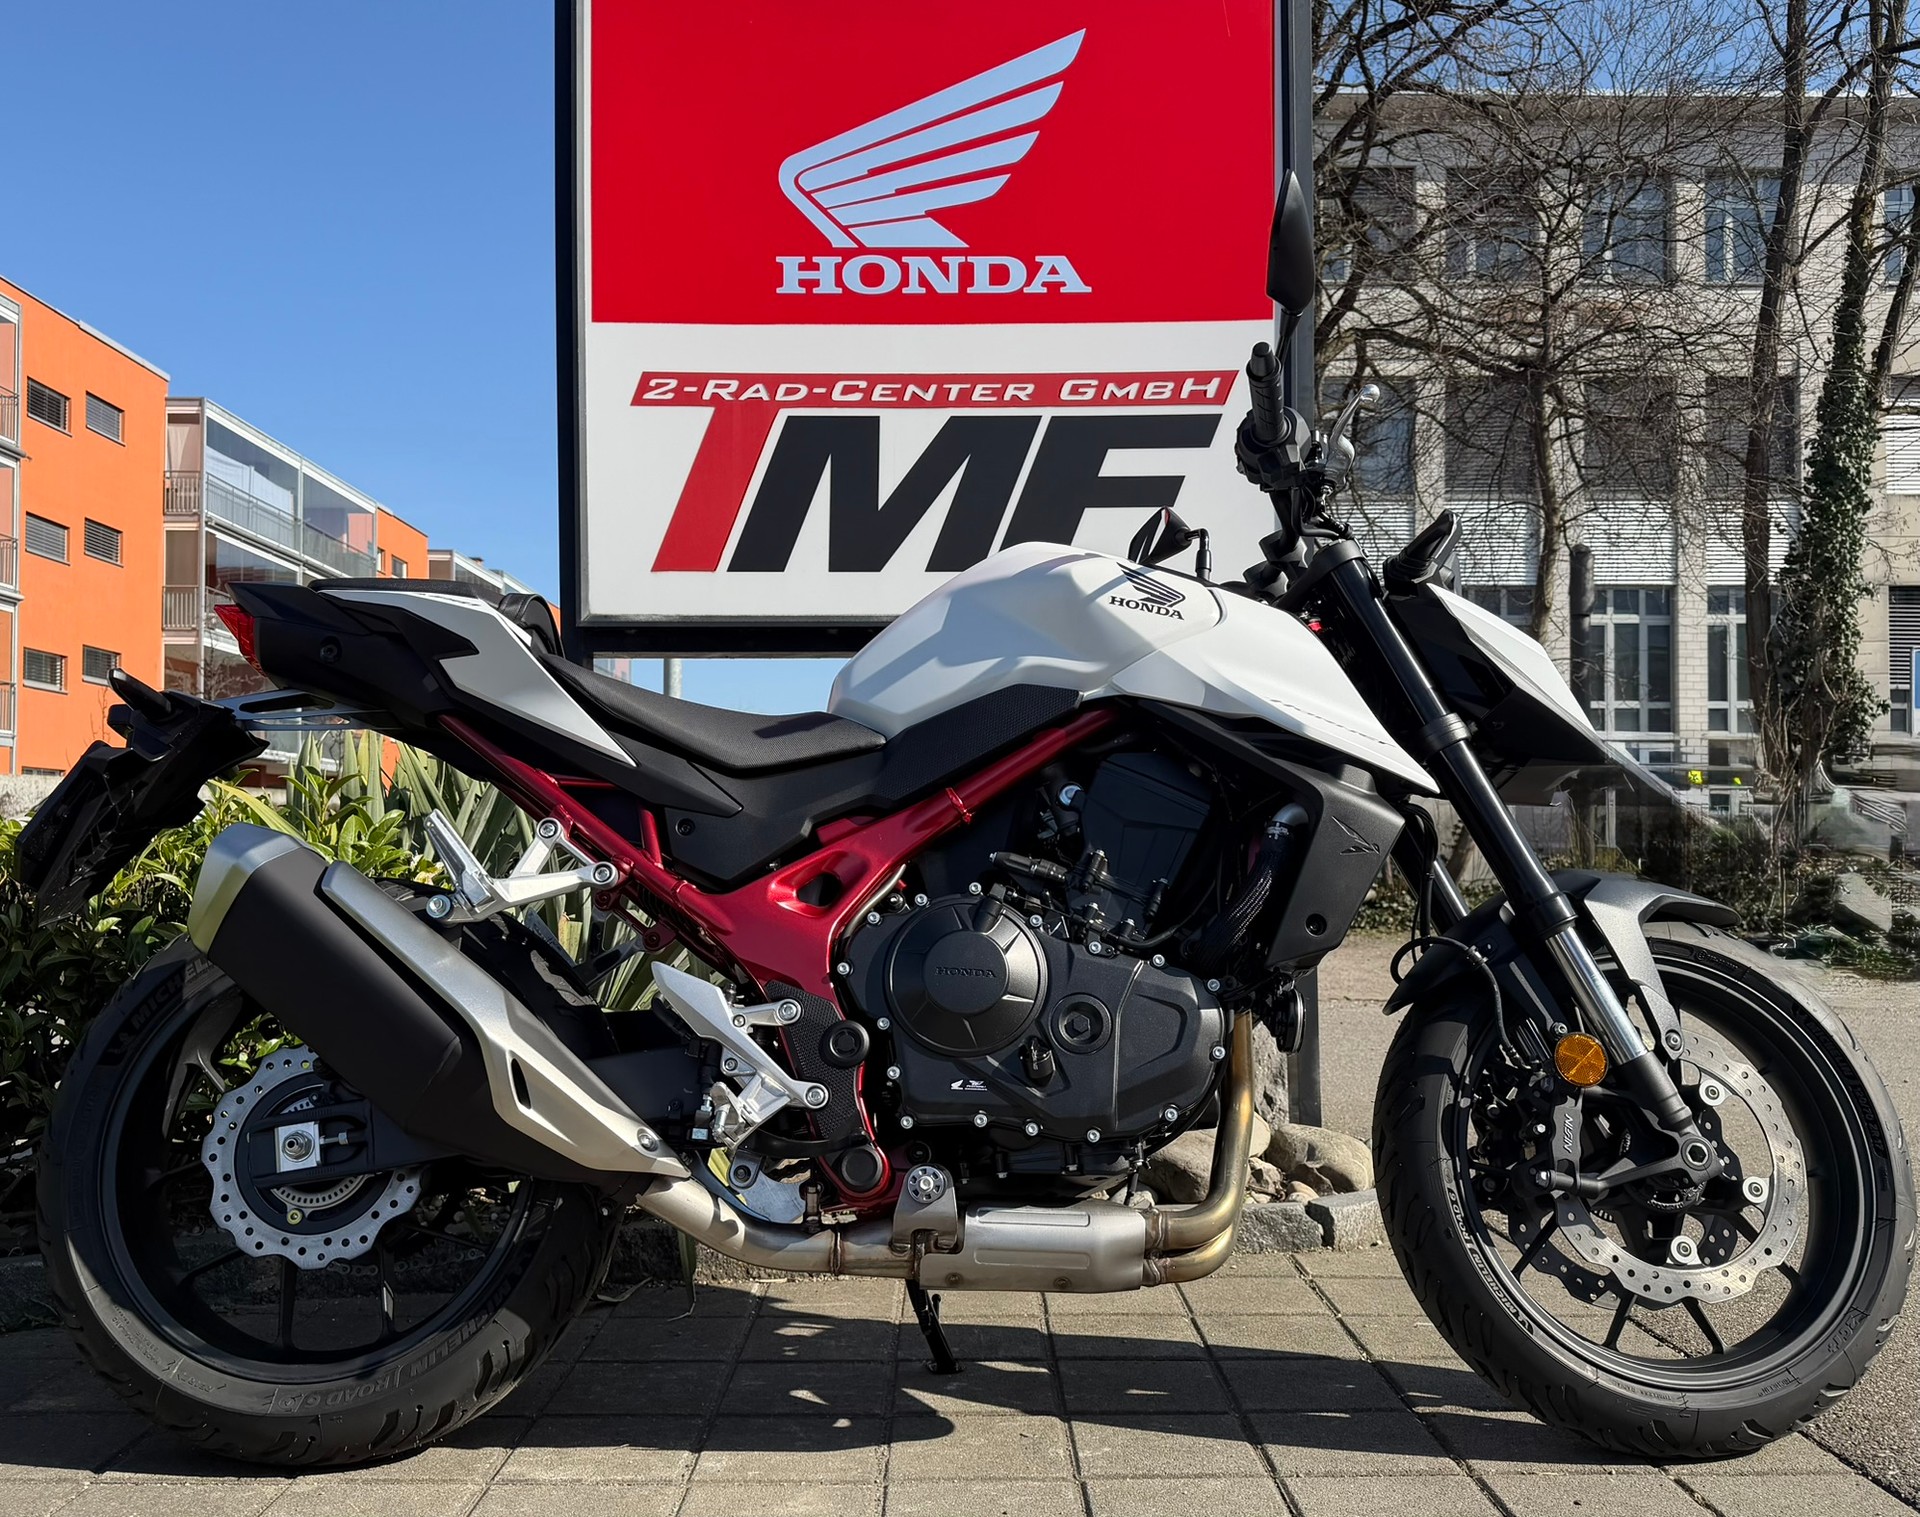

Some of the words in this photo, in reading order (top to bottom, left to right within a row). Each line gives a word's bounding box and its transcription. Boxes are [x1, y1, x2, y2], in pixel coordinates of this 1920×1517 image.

[776, 254, 1092, 294] HONDA
[650, 406, 1223, 573] TMF
[1109, 595, 1184, 620] HONDA
[934, 966, 997, 978] HONDA
[131, 957, 212, 1031] MICHEL
[1452, 1203, 1473, 1240] ROAD
[1472, 1252, 1517, 1314] MICHELIN
[325, 1377, 391, 1407] ROAD
